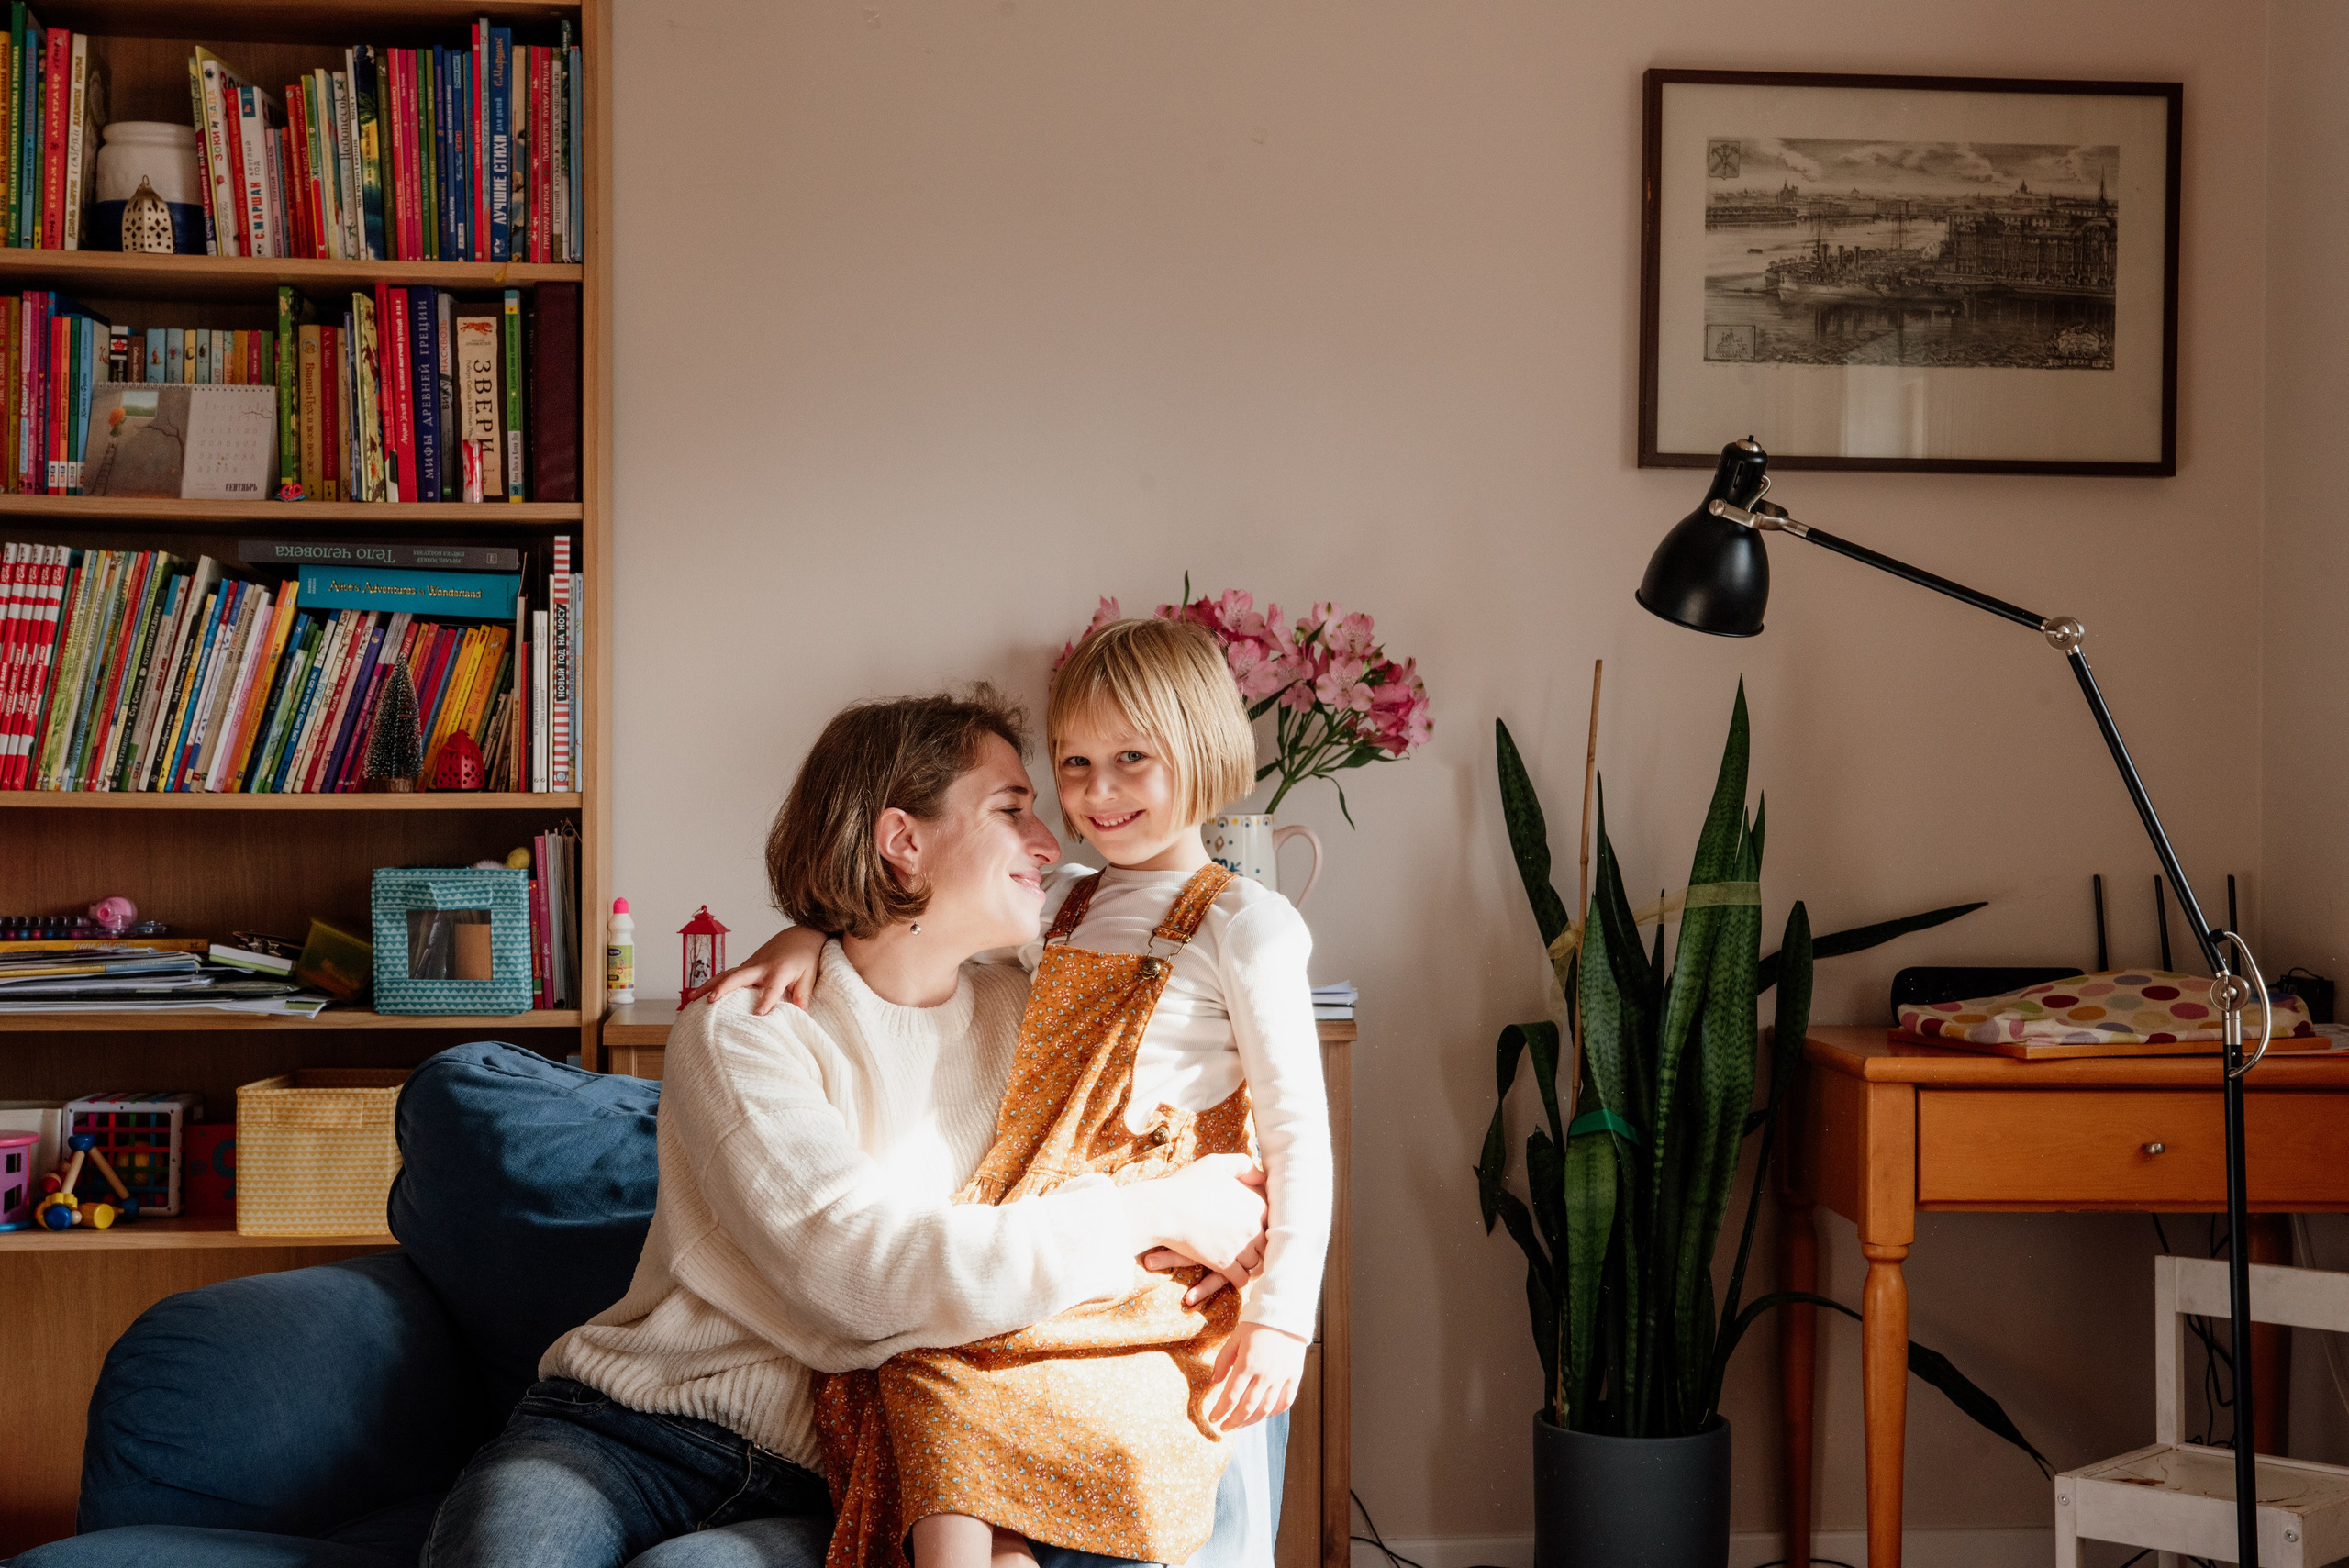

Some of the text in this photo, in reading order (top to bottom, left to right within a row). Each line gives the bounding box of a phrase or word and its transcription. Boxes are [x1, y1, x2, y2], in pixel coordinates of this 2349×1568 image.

[207, 89, 217, 117] БАДА
[212, 132, 223, 161] ЗОКИ
[245, 140, 254, 176] КРУГЛЫЙ
[493, 135, 507, 226] ЛУЧШИЕ СТИХИ
[440, 320, 449, 372] НАСКВОЗЬ
[305, 363, 317, 415] Винни-Пух
[418, 300, 434, 479] МИФЫ ДРЕВНЕЙ ГРЕЦИИ
[473, 360, 495, 453] ЗВЕРИ
[226, 484, 257, 492] СЕНТЯБРЬ
[275, 546, 395, 563] Тело человека
[328, 580, 360, 593] Alice's
[362, 582, 416, 595] Adventures
[426, 586, 483, 599] Wonderland
[164, 630, 173, 654] собирает
[170, 599, 182, 629] автомобиль
[230, 601, 248, 650] СУПЕРСПОСОБНОСТИ
[556, 607, 567, 697] НОВЫЙ ГОД НА НОСУ
[132, 679, 143, 703] Саймон
[314, 682, 326, 701] FOOT
[129, 705, 138, 717] Сэр
[295, 714, 306, 728] COMES
[118, 729, 131, 762] АТКИНСОН
[291, 729, 300, 743] BACK
